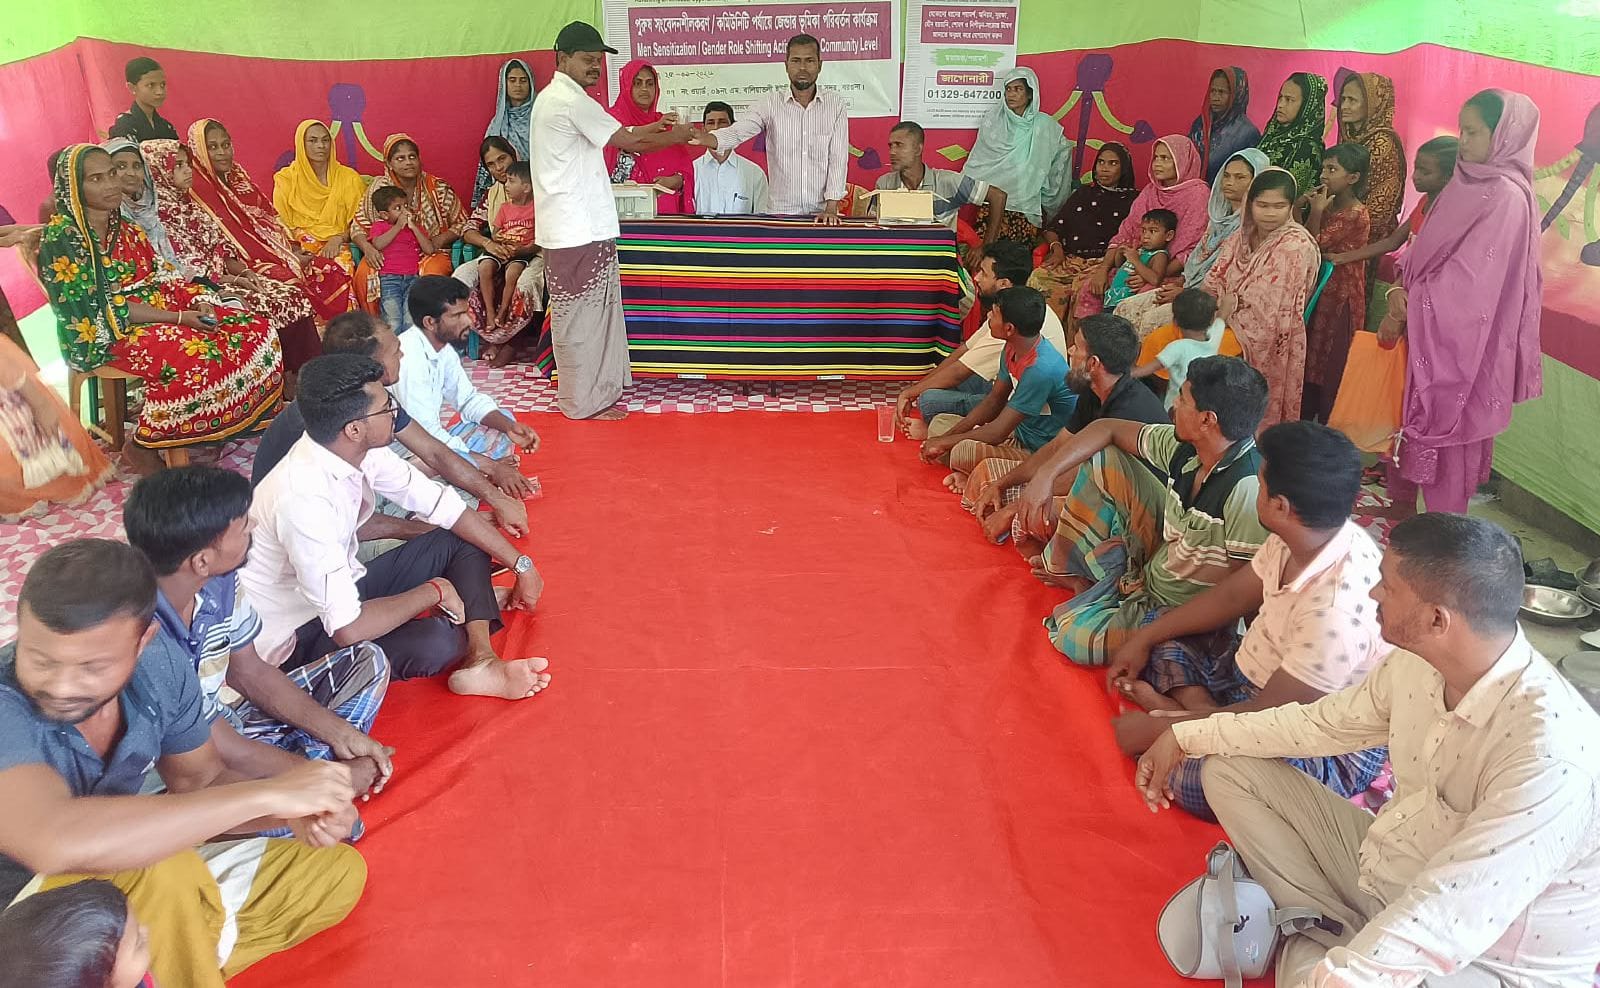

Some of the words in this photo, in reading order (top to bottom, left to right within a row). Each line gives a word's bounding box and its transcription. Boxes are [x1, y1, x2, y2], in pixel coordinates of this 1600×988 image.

[653, 12, 711, 34] সংবেদনশীলকরণ
[716, 11, 750, 31] কমিউনিটি
[775, 14, 797, 30] জেন্ডার
[799, 10, 820, 33] ভূমিকা
[823, 8, 850, 28] পরিবর্তন
[852, 8, 879, 27] কার্যক্রম
[637, 43, 652, 57] Men
[653, 42, 697, 57] Sensitization
[702, 40, 727, 55] Gender
[728, 40, 744, 54] Role
[745, 39, 772, 57] Shifting
[820, 37, 858, 54] Community
[860, 36, 878, 52] Level
[940, 73, 990, 84] জাগোনারী
[927, 89, 1002, 100] 01329-647200
